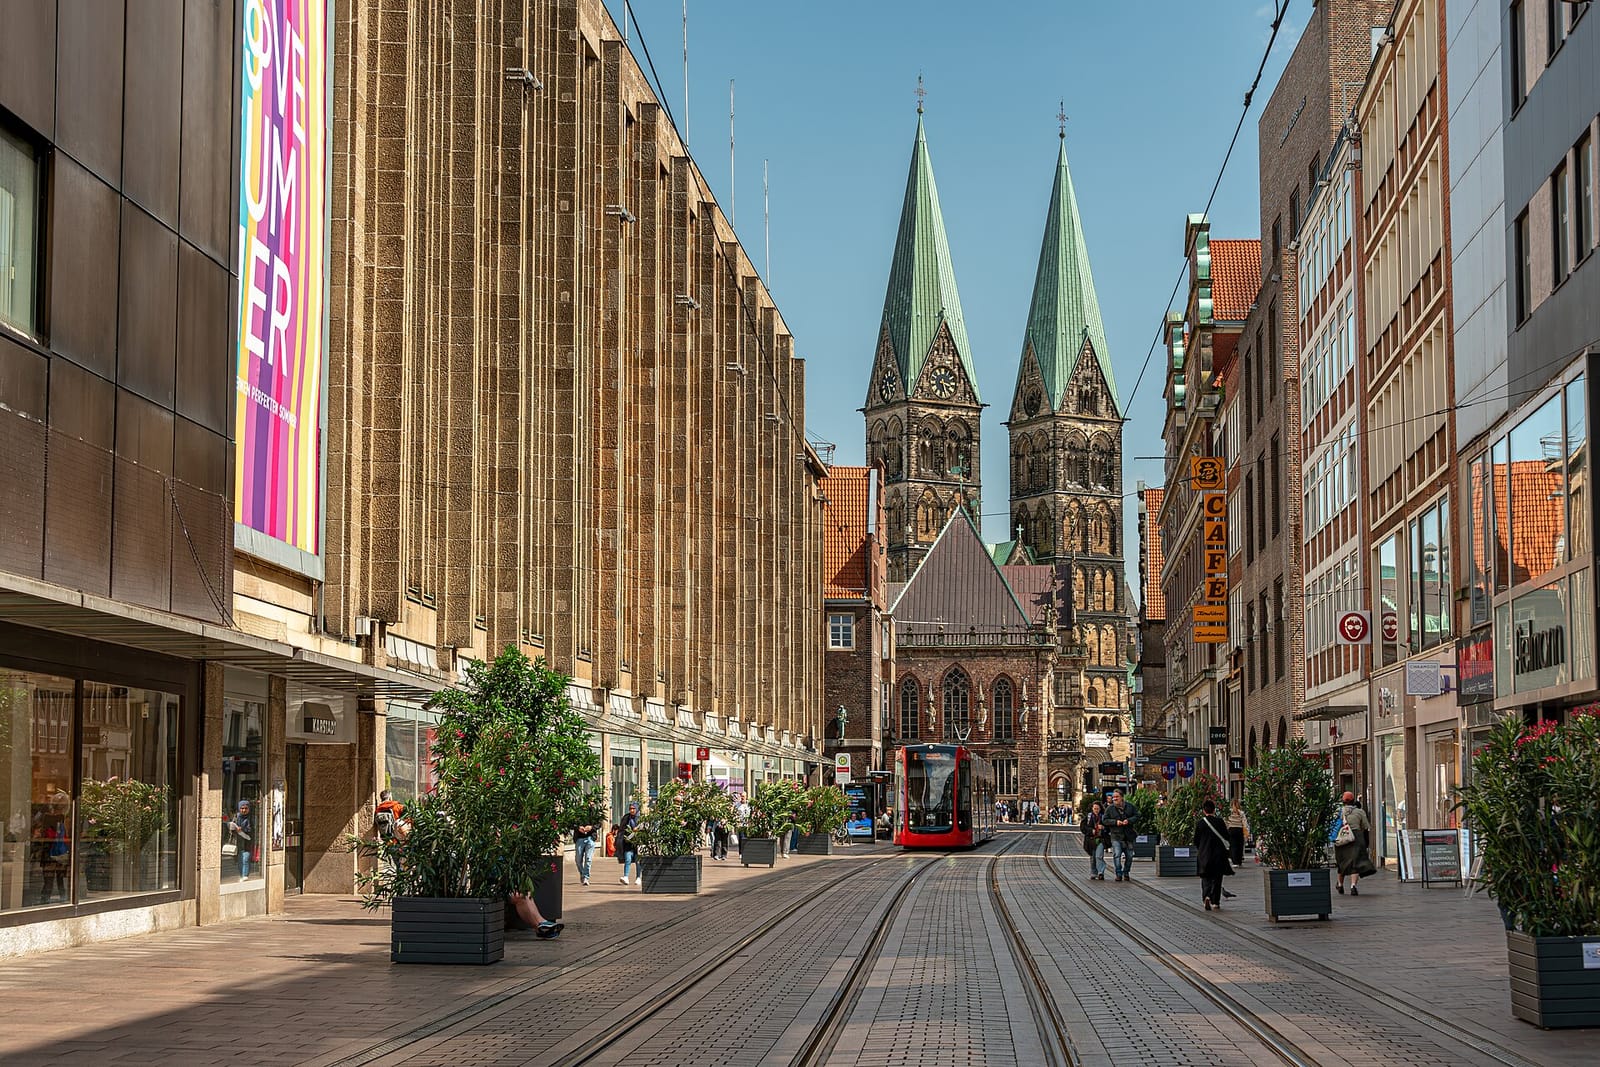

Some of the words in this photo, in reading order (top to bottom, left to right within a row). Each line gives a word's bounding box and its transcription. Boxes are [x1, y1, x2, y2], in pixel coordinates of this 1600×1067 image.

[246, 0, 305, 146] OVE
[244, 96, 297, 256] UM
[239, 225, 292, 377] ER
[251, 385, 279, 416] PERFEKTEN
[279, 404, 297, 429] SOMMER
[1206, 496, 1225, 598] CAFÉ
